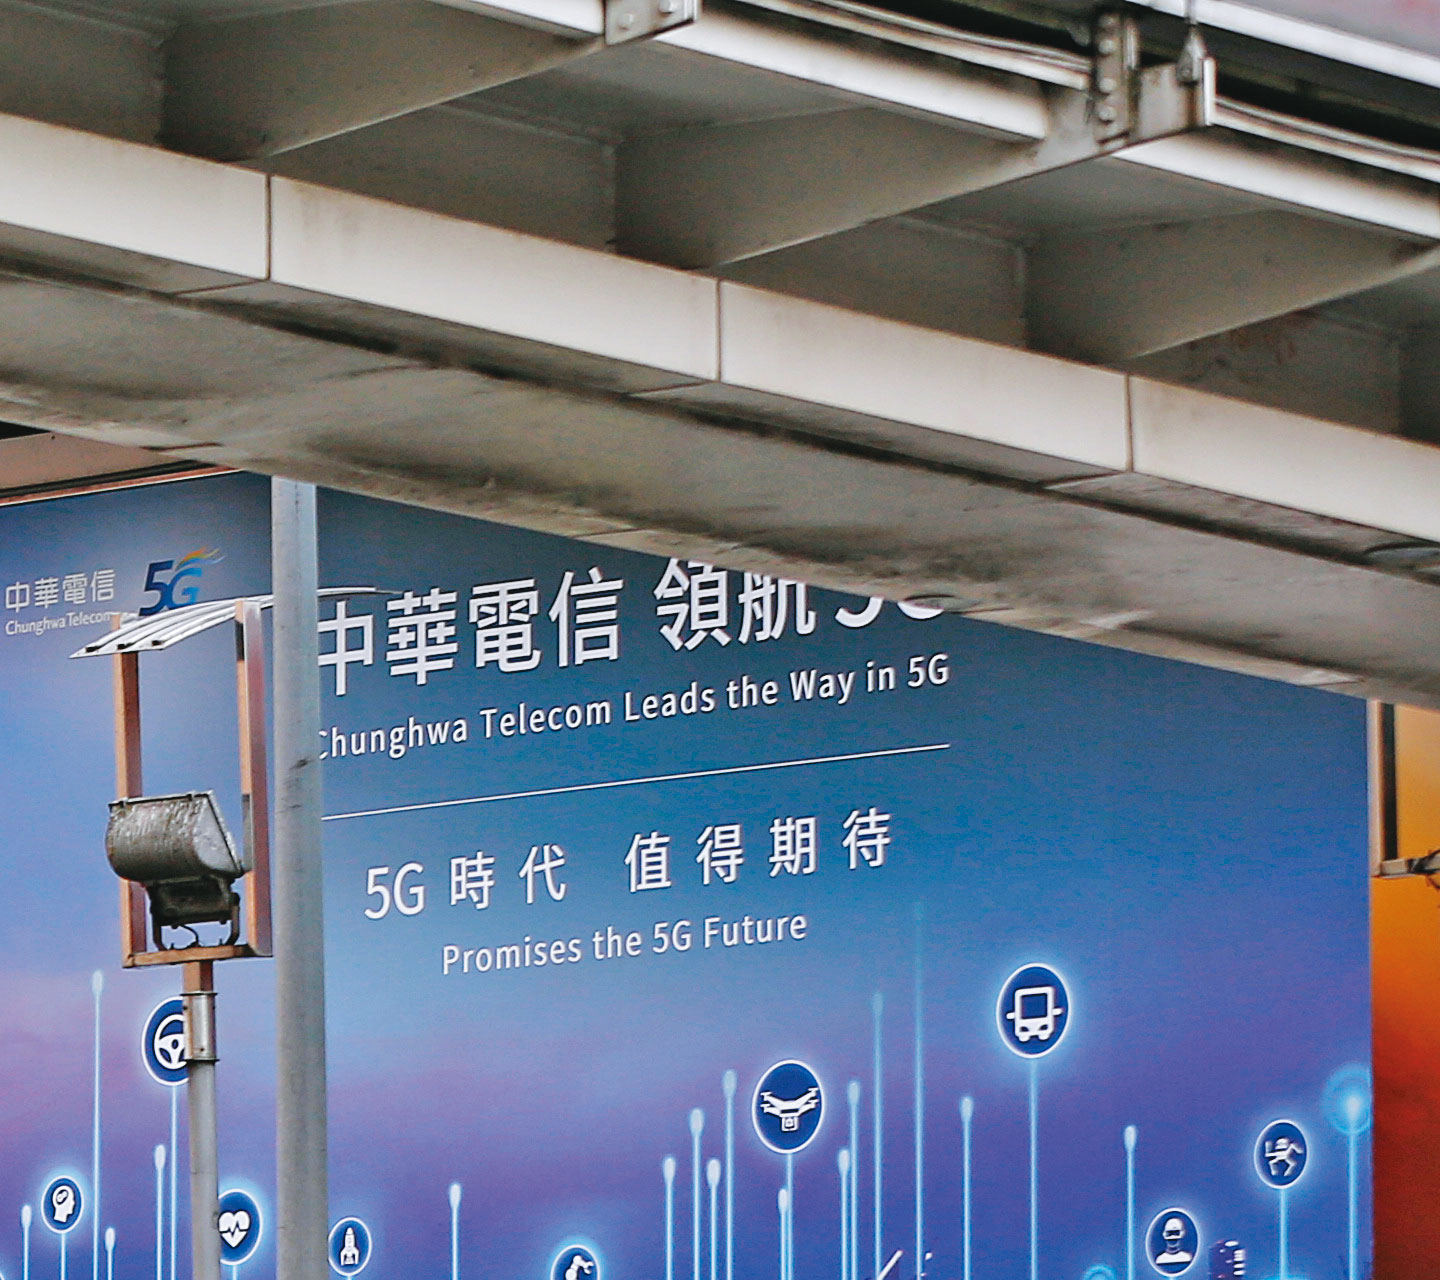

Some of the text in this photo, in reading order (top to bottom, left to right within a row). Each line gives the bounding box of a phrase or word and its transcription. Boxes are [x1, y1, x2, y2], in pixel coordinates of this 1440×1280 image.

[5, 568, 116, 613] 中華電信
[5, 615, 66, 637] Chunghwa
[316, 565, 624, 697] 中華電信
[480, 701, 612, 739] Telecom
[623, 681, 715, 723] Leads
[725, 676, 779, 709] the
[789, 666, 855, 705] Way
[865, 661, 896, 692] in
[906, 653, 950, 688] 5G
[623, 805, 892, 895] 值得期待
[441, 911, 808, 976] Promises the 5G Future
